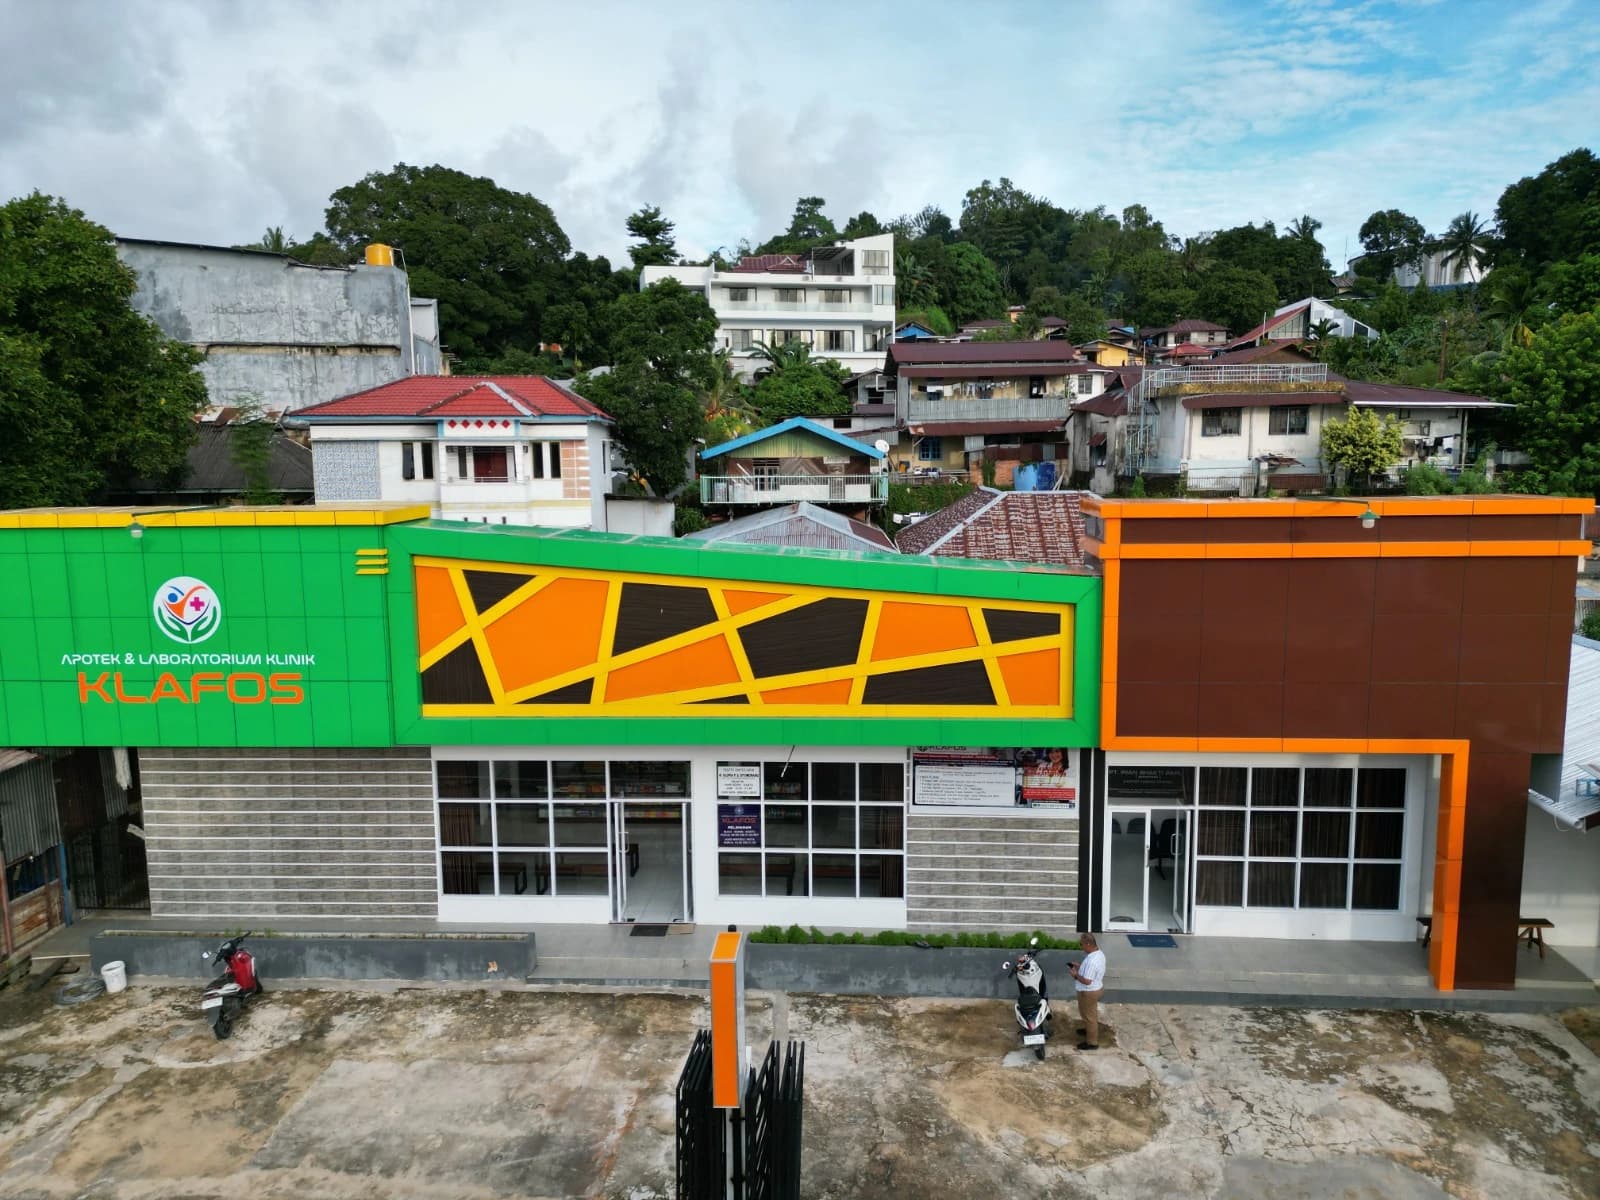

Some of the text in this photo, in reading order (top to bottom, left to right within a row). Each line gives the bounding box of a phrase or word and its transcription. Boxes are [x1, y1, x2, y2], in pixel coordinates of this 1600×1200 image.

[62, 653, 314, 664] APOTEK & LABORATORIUM KLINIK
[78, 672, 304, 704] KLAFOS
